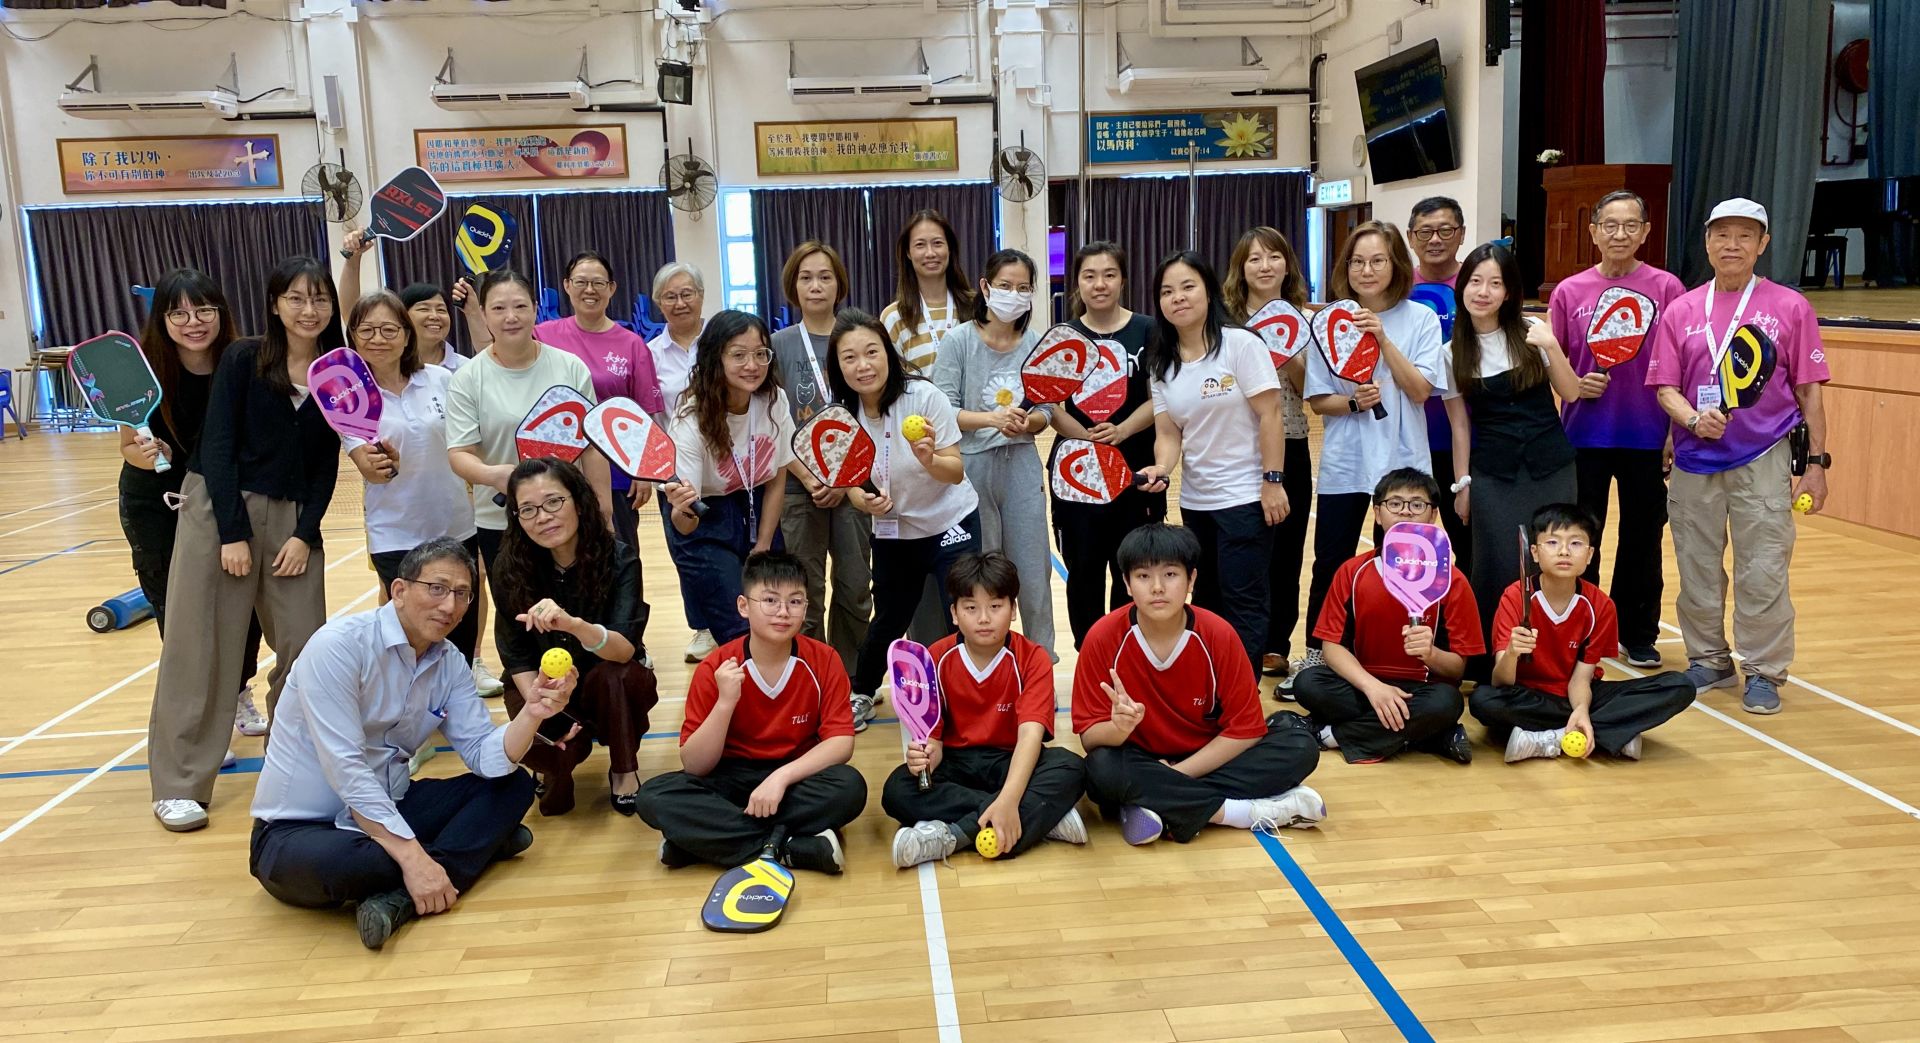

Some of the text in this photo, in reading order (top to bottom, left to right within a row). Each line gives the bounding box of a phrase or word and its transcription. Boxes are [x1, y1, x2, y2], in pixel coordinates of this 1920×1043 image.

[1597, 353, 1616, 363] HEAD
[1353, 366, 1371, 378] HEAD
[329, 380, 364, 404] Quickhand
[1027, 385, 1046, 400] HEAD
[652, 461, 671, 476] HEAD
[848, 466, 867, 483] HEAD
[1119, 466, 1127, 489] HEAD
[940, 531, 972, 547] adidas
[1394, 556, 1438, 567] Quickhand
[900, 676, 930, 690] Quickhand
